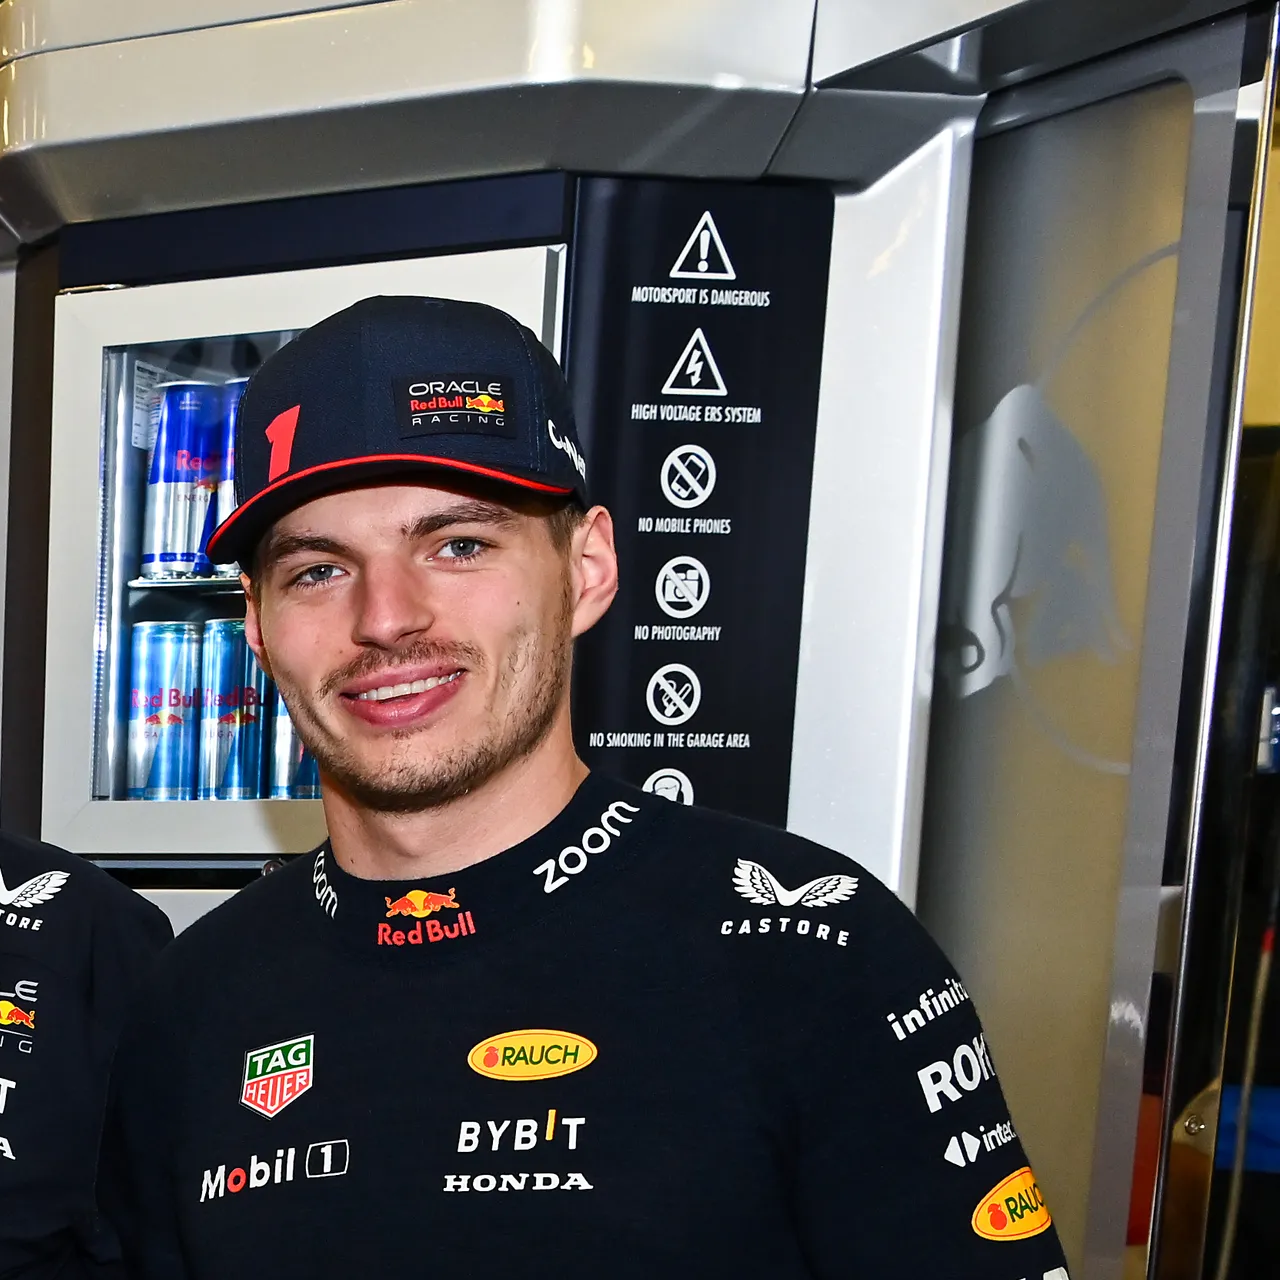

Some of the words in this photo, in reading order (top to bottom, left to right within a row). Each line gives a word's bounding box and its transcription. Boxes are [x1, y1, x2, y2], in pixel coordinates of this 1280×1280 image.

[631, 286, 697, 304] MOTORSPORT
[699, 288, 709, 305] IS
[711, 289, 771, 307] DANGEROUS
[408, 380, 502, 397] ORACLE
[410, 398, 436, 412] Red
[437, 395, 463, 410] Bull
[631, 404, 658, 421] HIGH
[660, 405, 702, 422] VOLTAGE
[704, 406, 723, 422] ERS
[724, 406, 762, 424] SYSTEM
[411, 413, 505, 427] RACING
[265, 404, 301, 483] 1
[638, 517, 653, 533] NO
[655, 518, 692, 534] MOBILE
[693, 518, 732, 535] PHONES
[634, 625, 650, 641] NO
[651, 625, 722, 642] PHOTOGRAPHY
[589, 733, 605, 748] NO
[606, 733, 652, 748] SMOKING
[653, 733, 665, 748] IN
[667, 733, 685, 748] THE
[687, 733, 725, 749] GARAGE
[726, 733, 751, 748] AREA
[533, 801, 640, 894] zoom
[377, 920, 422, 946] Red
[427, 910, 476, 943] Bull
[720, 917, 850, 947] CASTORE
[251, 1041, 307, 1076] TAG
[501, 1043, 580, 1067] RAUCH
[917, 1032, 996, 1114] ROK
[245, 1073, 309, 1112] HEUER
[457, 1109, 586, 1153] BYBIT
[200, 1147, 297, 1203] Mobil
[320, 1144, 333, 1173] 1
[443, 1172, 594, 1193] HONDA
[1004, 1183, 1044, 1222] RAUC
